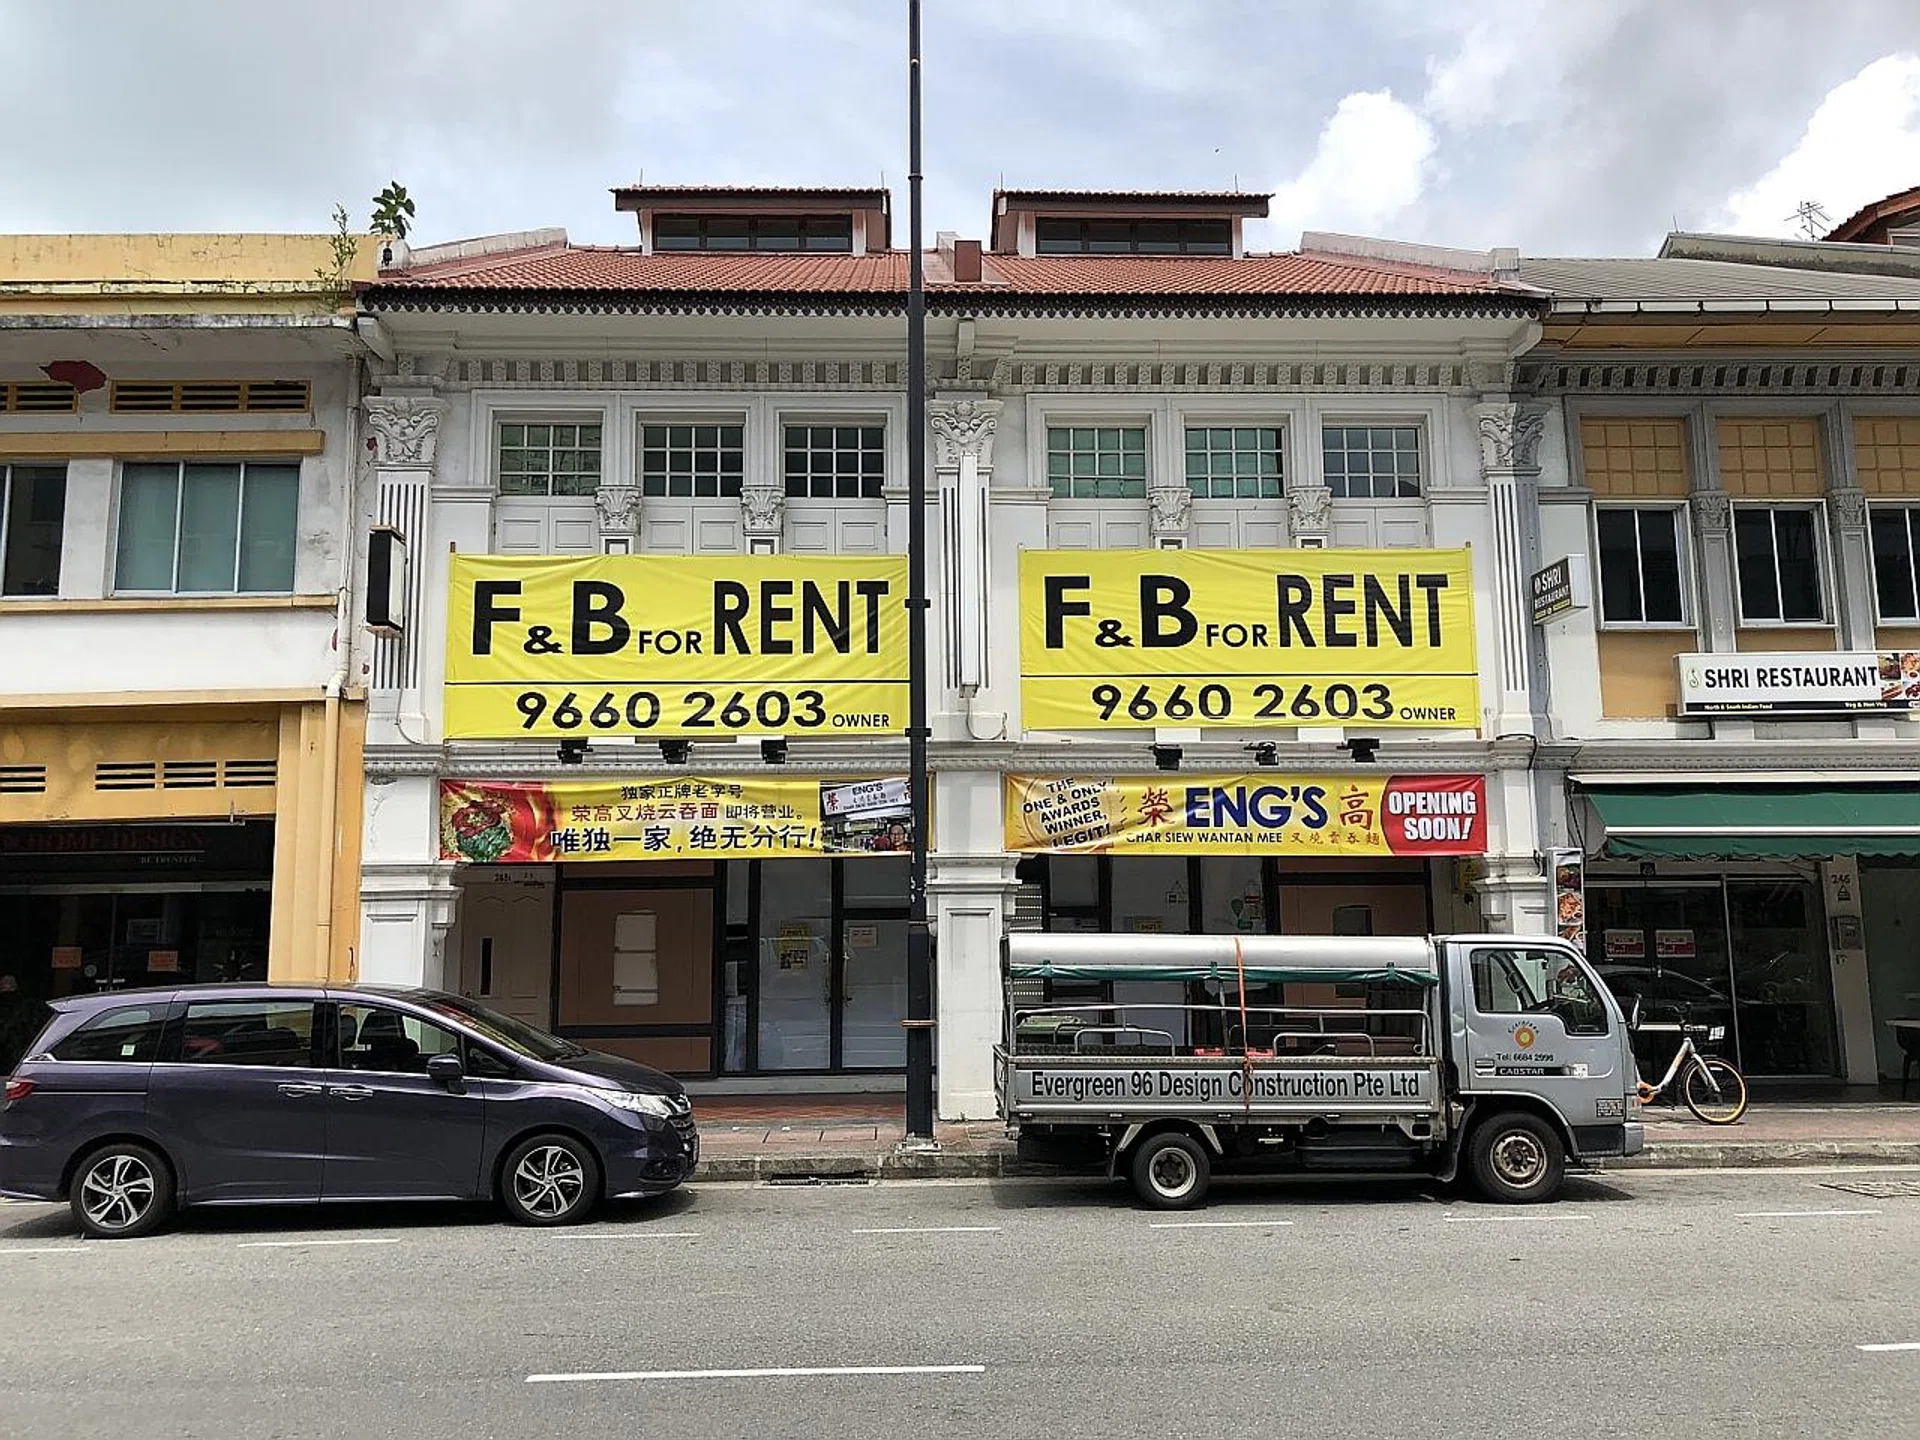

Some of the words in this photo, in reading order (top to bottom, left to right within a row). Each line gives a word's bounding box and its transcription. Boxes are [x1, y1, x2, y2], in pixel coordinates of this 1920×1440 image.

[1542, 566, 1561, 591] SHRI
[639, 630, 703, 655] FOR
[713, 580, 890, 655] RENT
[1205, 624, 1268, 648] FOR
[1276, 573, 1449, 648] RENT
[1704, 668, 1750, 689] SHRI
[1757, 666, 1878, 688] RESTAURANT
[516, 691, 661, 729] 9660
[680, 690, 827, 728] 2603
[831, 713, 891, 729] OWNER
[1091, 684, 1232, 721] 9660
[1252, 683, 1394, 720] 2603
[1399, 706, 1457, 721] OWNER
[621, 784, 744, 801] 独家正牌老字号
[1023, 797, 1053, 814] ONE
[1057, 793, 1067, 805] &
[1071, 781, 1107, 800] ONLY
[1046, 777, 1075, 793] THE
[1041, 796, 1101, 824] AWARDS
[1137, 786, 1175, 828] 榮
[1184, 785, 1329, 830] ENG'S
[1339, 784, 1375, 831] 高
[1388, 790, 1477, 815] OPENING
[1044, 810, 1107, 835] WINNER,
[1403, 817, 1473, 840] SOON!
[1126, 832, 1161, 843] CHAR
[1165, 832, 1194, 843] SIEW
[1197, 832, 1254, 843] WANTAN
[1256, 832, 1283, 843] MEE
[1499, 1067, 1545, 1075] CABSTAR
[1031, 1070, 1126, 1102] Evergreen
[1131, 1071, 1153, 1097] 96
[1159, 1070, 1222, 1102] Design
[1228, 1071, 1347, 1097] Construction
[1353, 1071, 1384, 1097] Pte
[1390, 1071, 1420, 1097] Ltd
